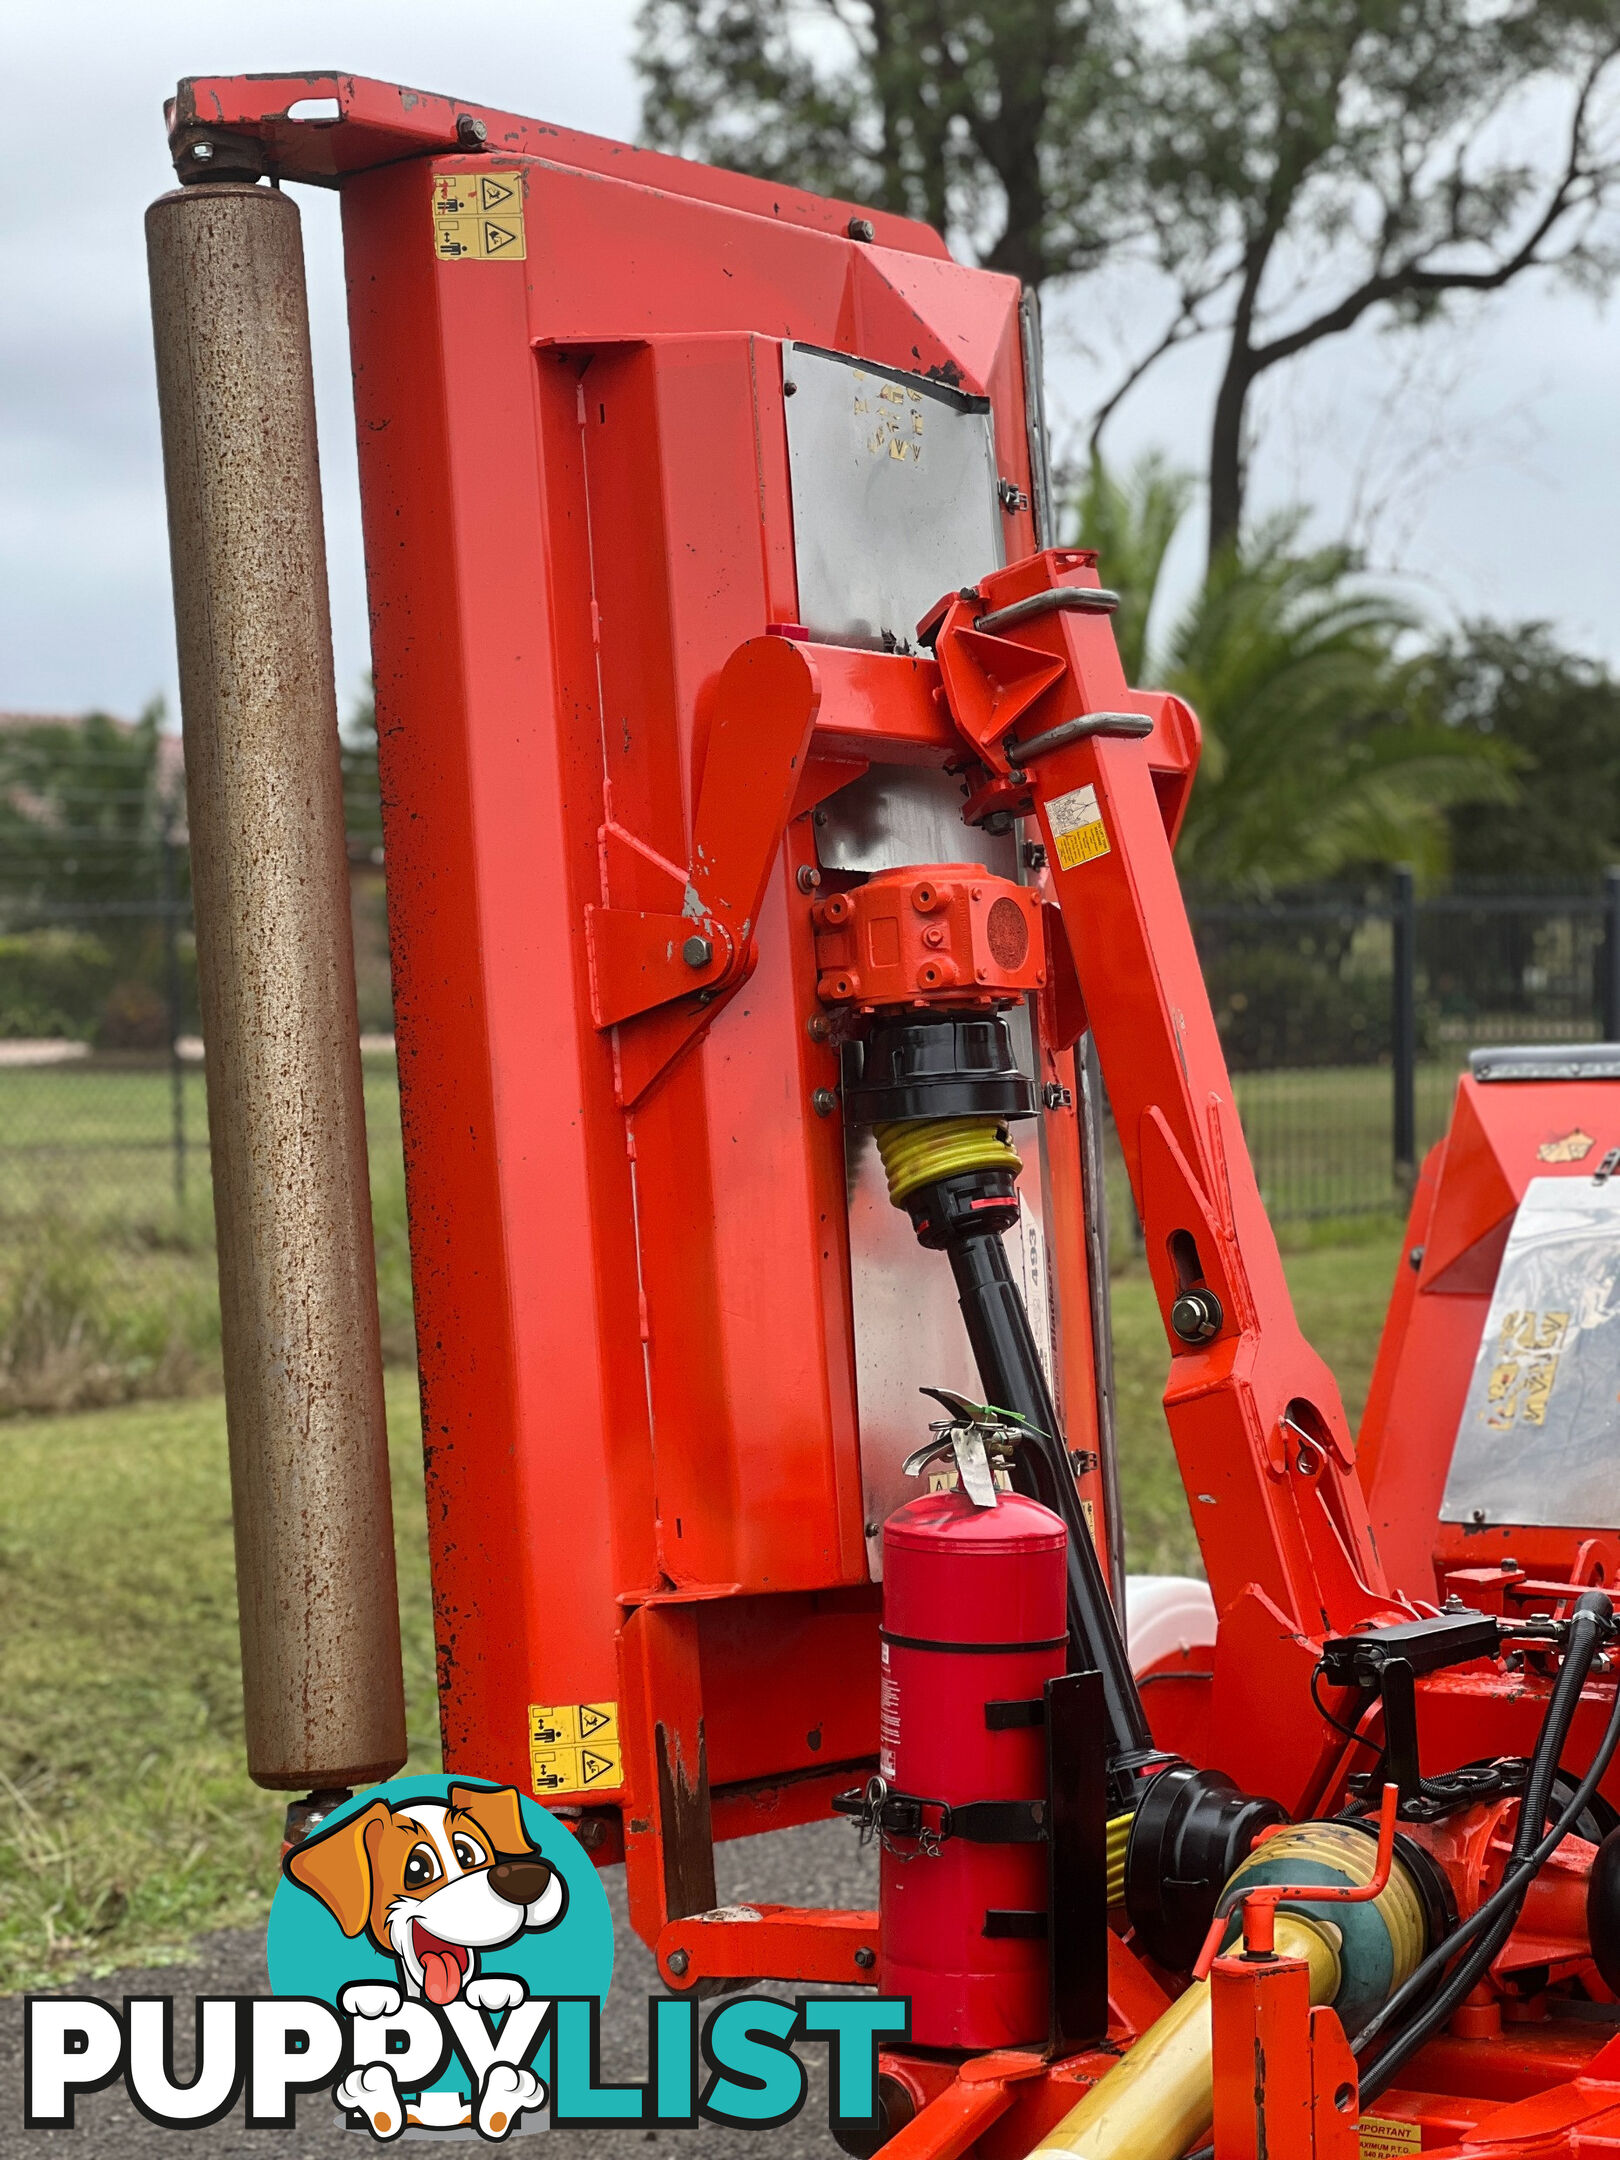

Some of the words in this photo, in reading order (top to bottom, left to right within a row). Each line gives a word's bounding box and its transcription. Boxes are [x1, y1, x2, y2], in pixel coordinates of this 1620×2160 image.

[1029, 1228, 1038, 1287] 493
[1359, 2124, 1411, 2138] MPORTANT
[1360, 2141, 1389, 2151] AXIMUM
